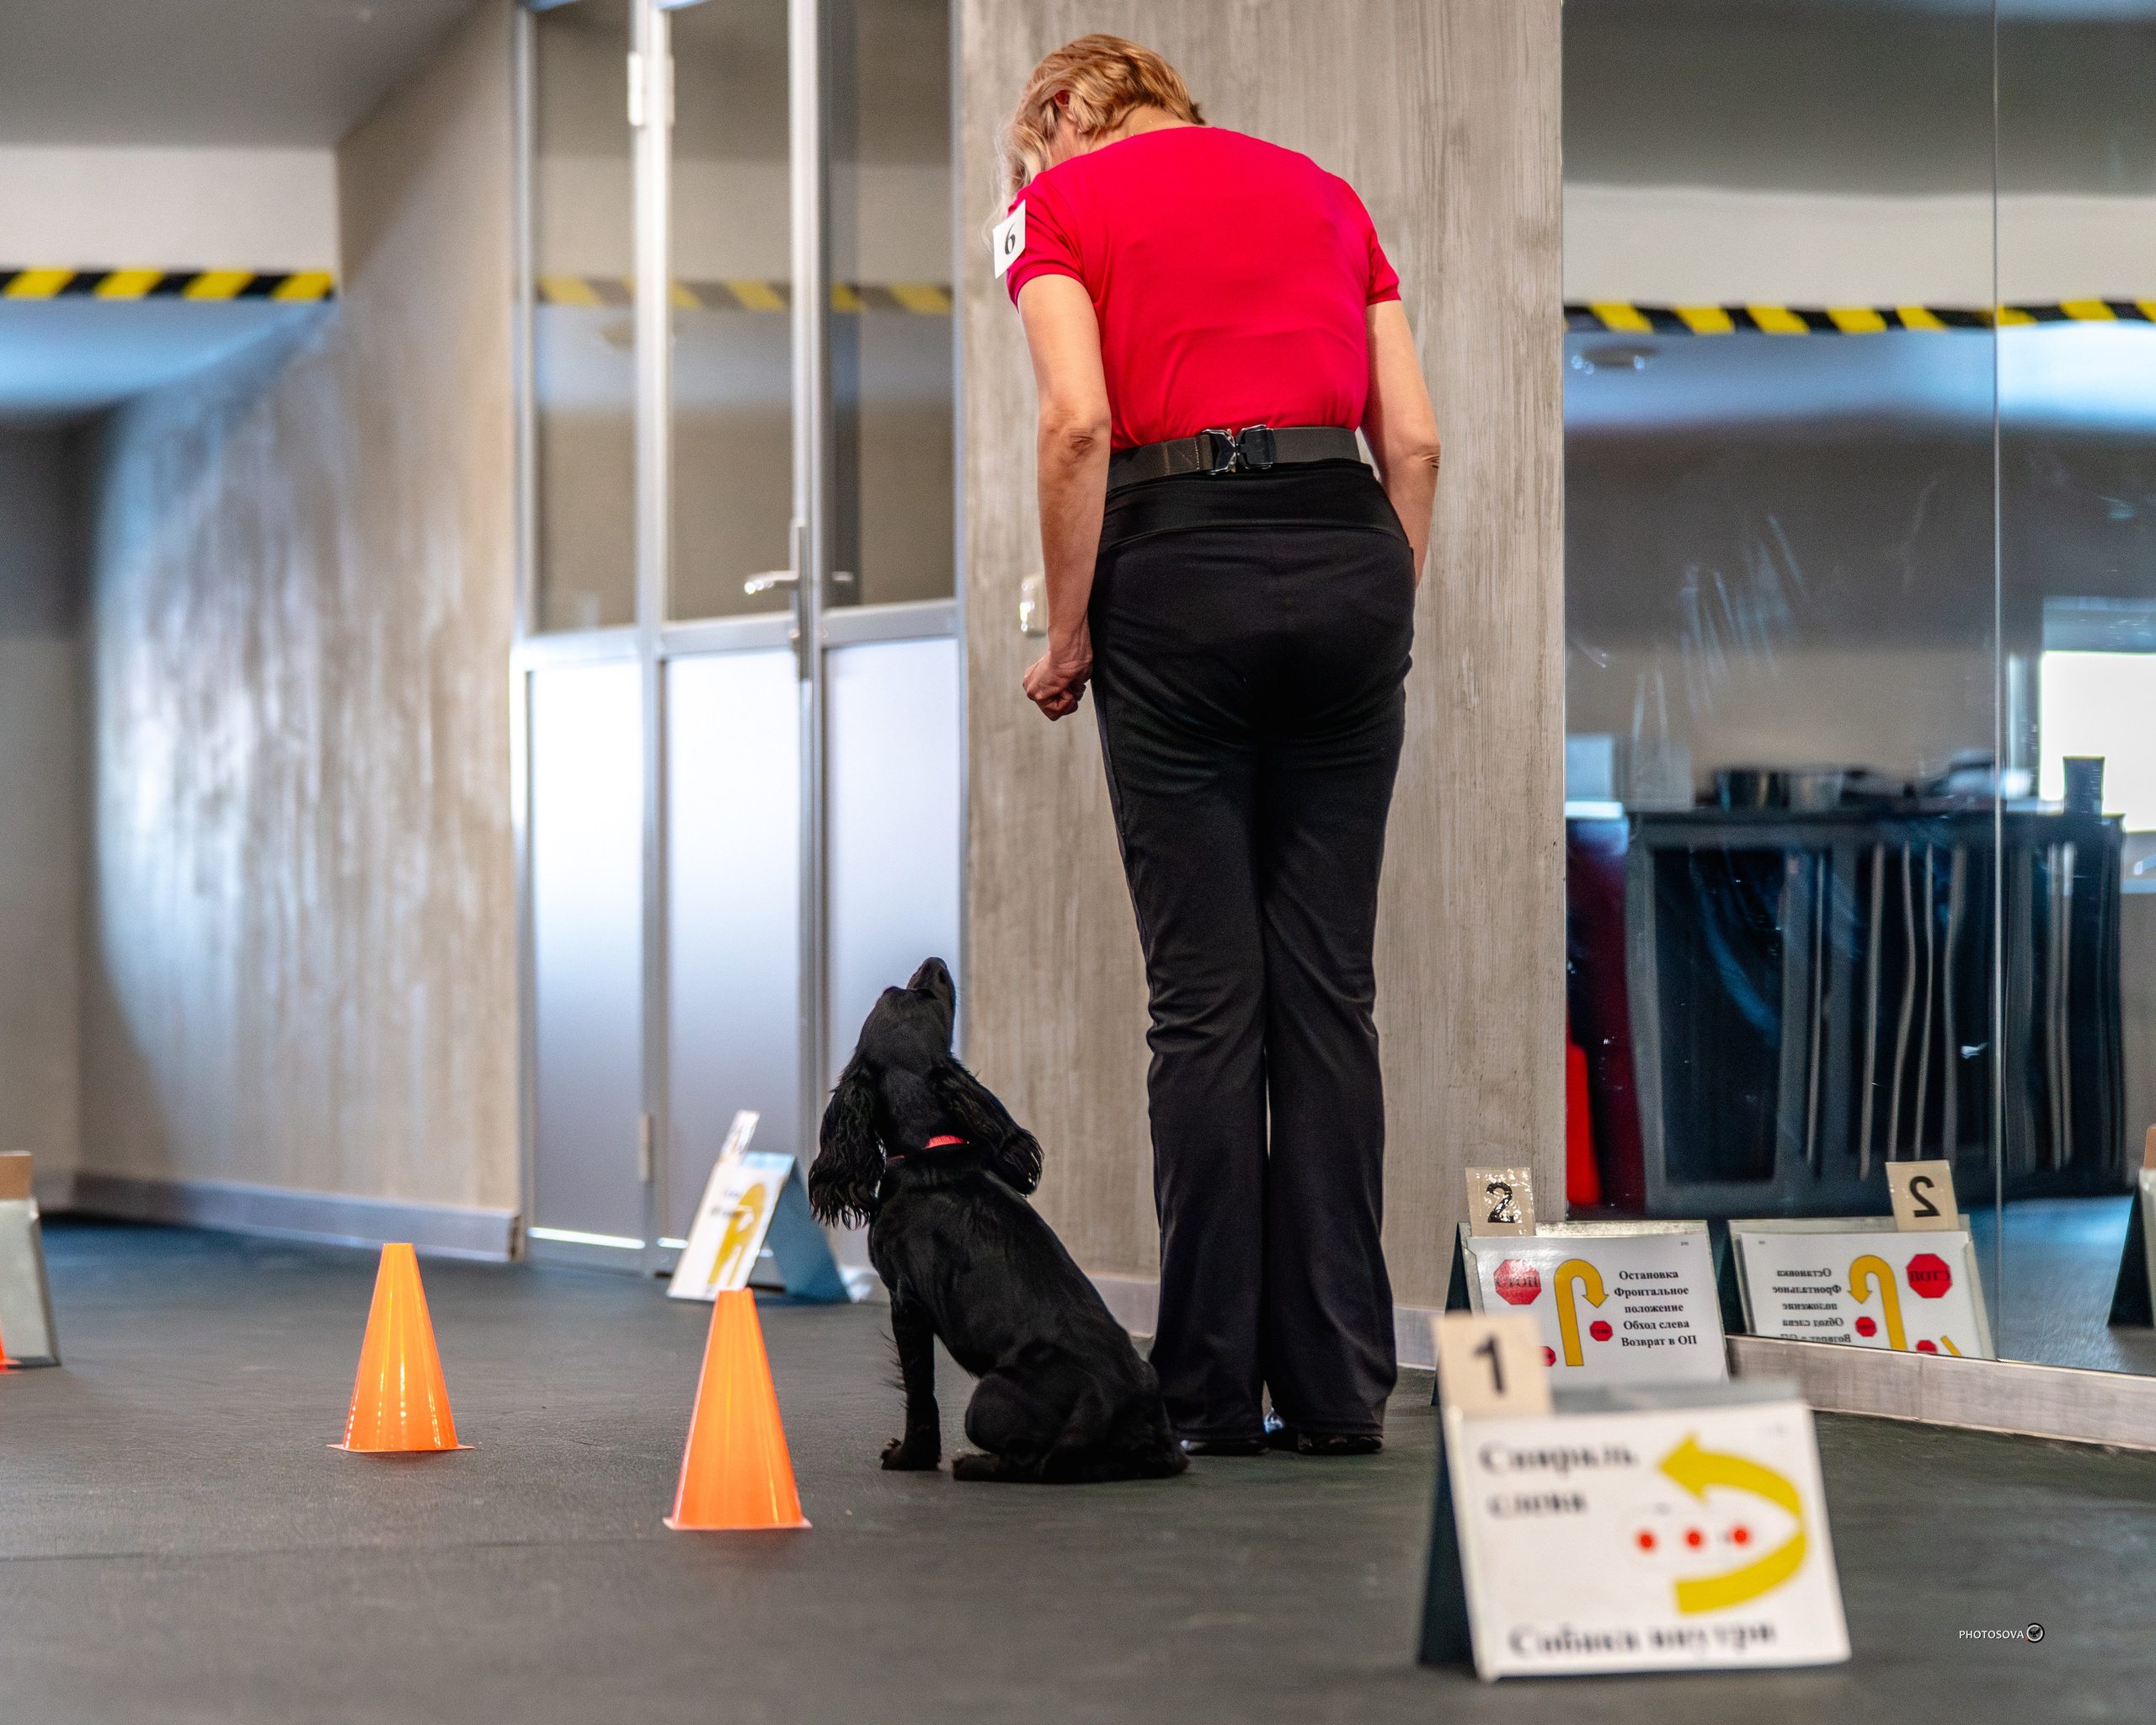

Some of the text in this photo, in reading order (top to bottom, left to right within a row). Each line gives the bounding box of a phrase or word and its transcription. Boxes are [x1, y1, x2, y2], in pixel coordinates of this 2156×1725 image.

[1005, 222, 1016, 255] 6
[1486, 1182, 1516, 1223] 2
[1619, 1271, 1679, 1280] Остановка
[1614, 1287, 1689, 1299] Фронтальное
[1625, 1305, 1684, 1313] положение
[1624, 1321, 1690, 1330] Обход слева
[1621, 1337, 1666, 1348] Возврат
[1678, 1335, 1697, 1345] ОП
[1471, 1333, 1506, 1397] 1
